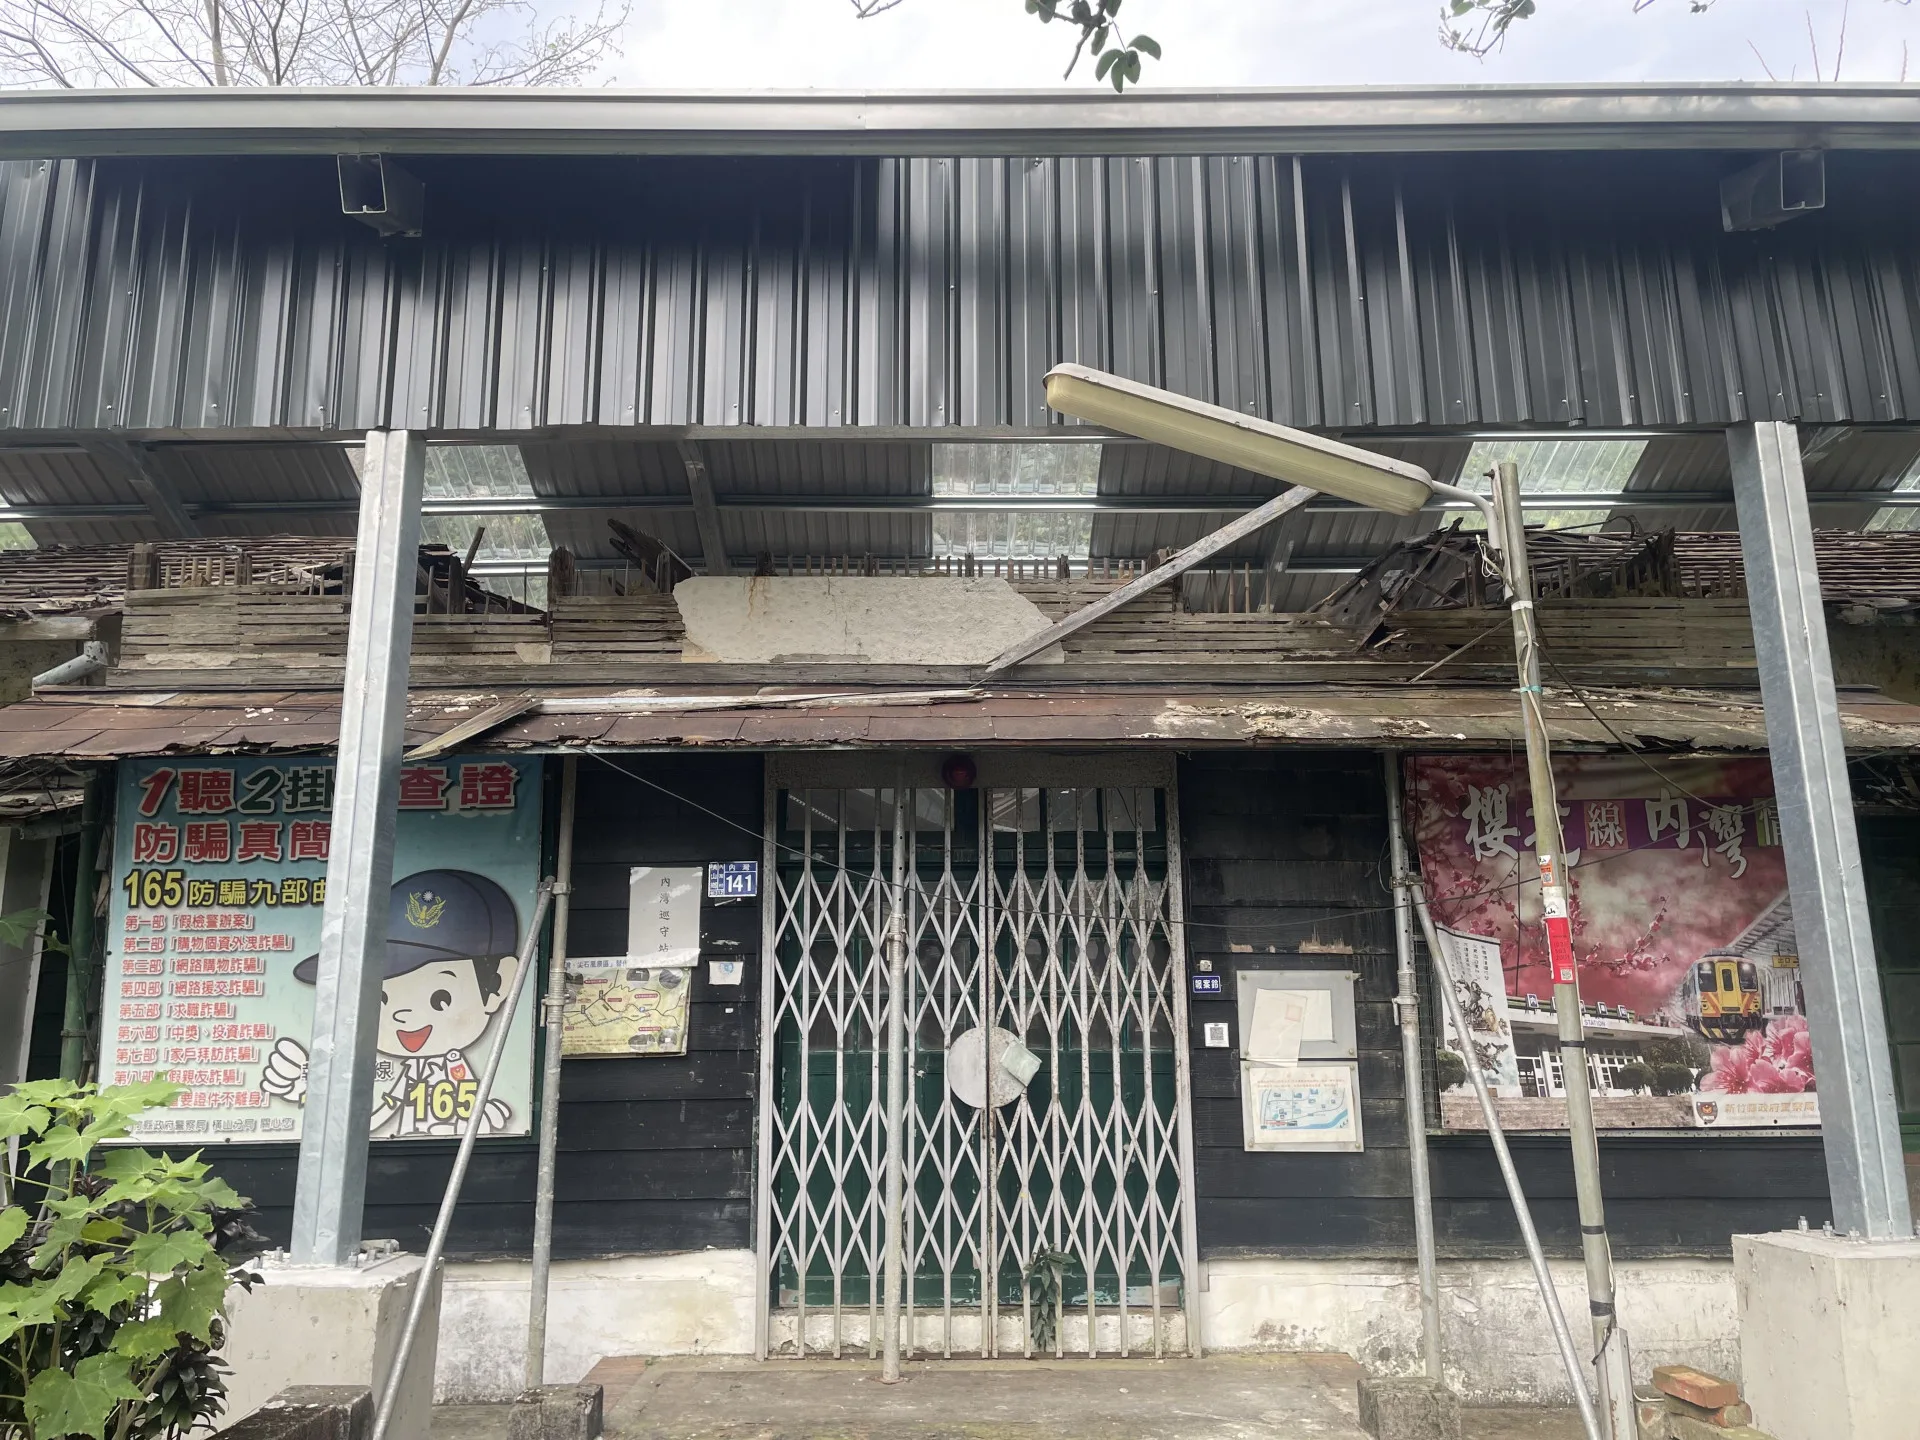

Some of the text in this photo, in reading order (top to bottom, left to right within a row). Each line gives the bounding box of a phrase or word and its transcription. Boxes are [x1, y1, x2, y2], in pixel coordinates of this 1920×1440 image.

[132, 819, 330, 863] 防騙真簡
[726, 874, 752, 892] 141
[658, 877, 671, 952] 內灣巡守站
[1195, 979, 1219, 989] 報案鈴
[1584, 1019, 1606, 1027] STATION
[409, 1080, 480, 1121] 165
